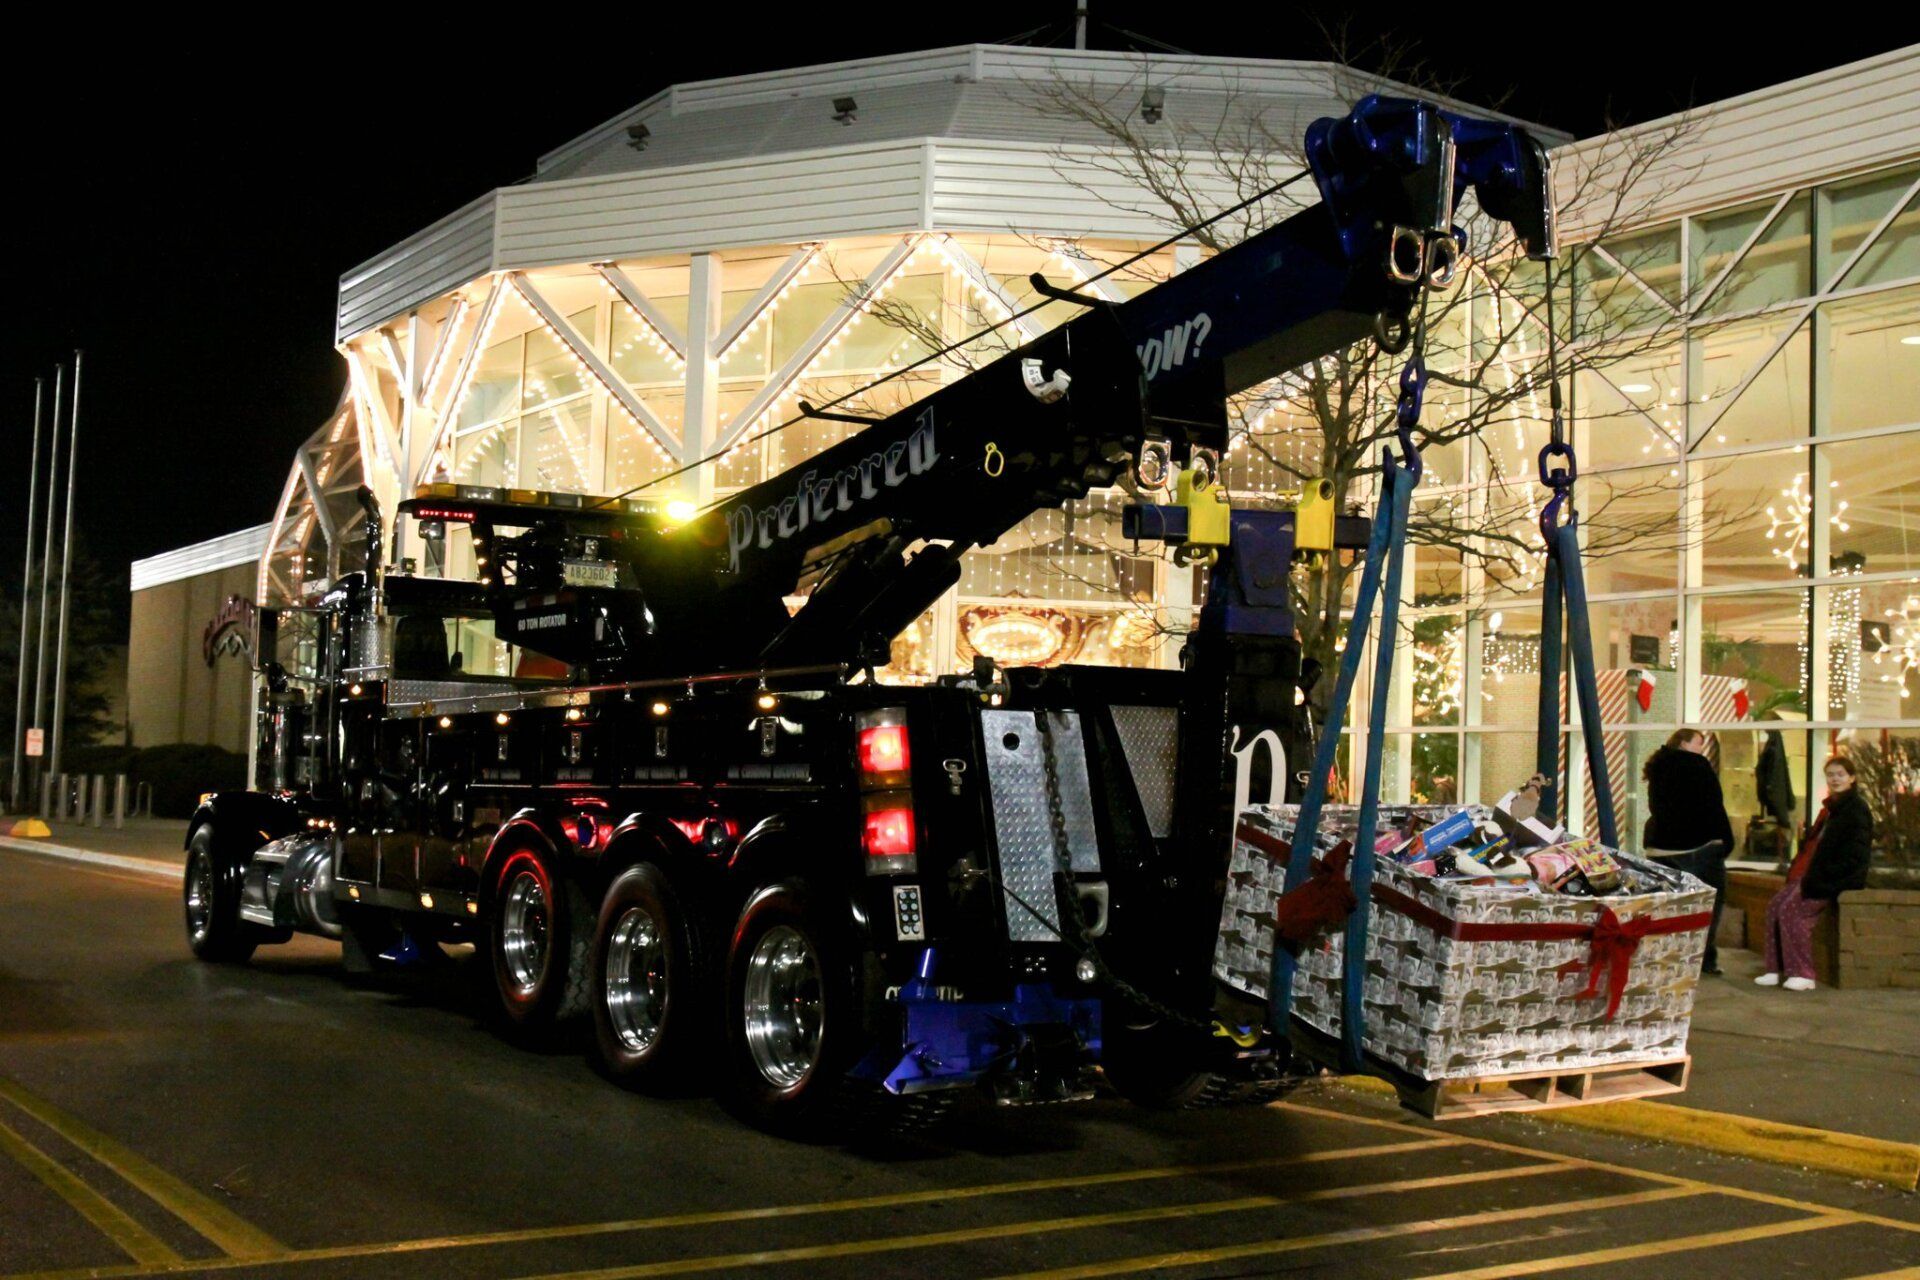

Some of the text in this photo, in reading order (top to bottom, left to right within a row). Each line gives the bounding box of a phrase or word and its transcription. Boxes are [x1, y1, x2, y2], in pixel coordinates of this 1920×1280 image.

[1136, 311, 1213, 382] OW?
[527, 617, 539, 630] TON
[539, 613, 567, 629] ROTATOR
